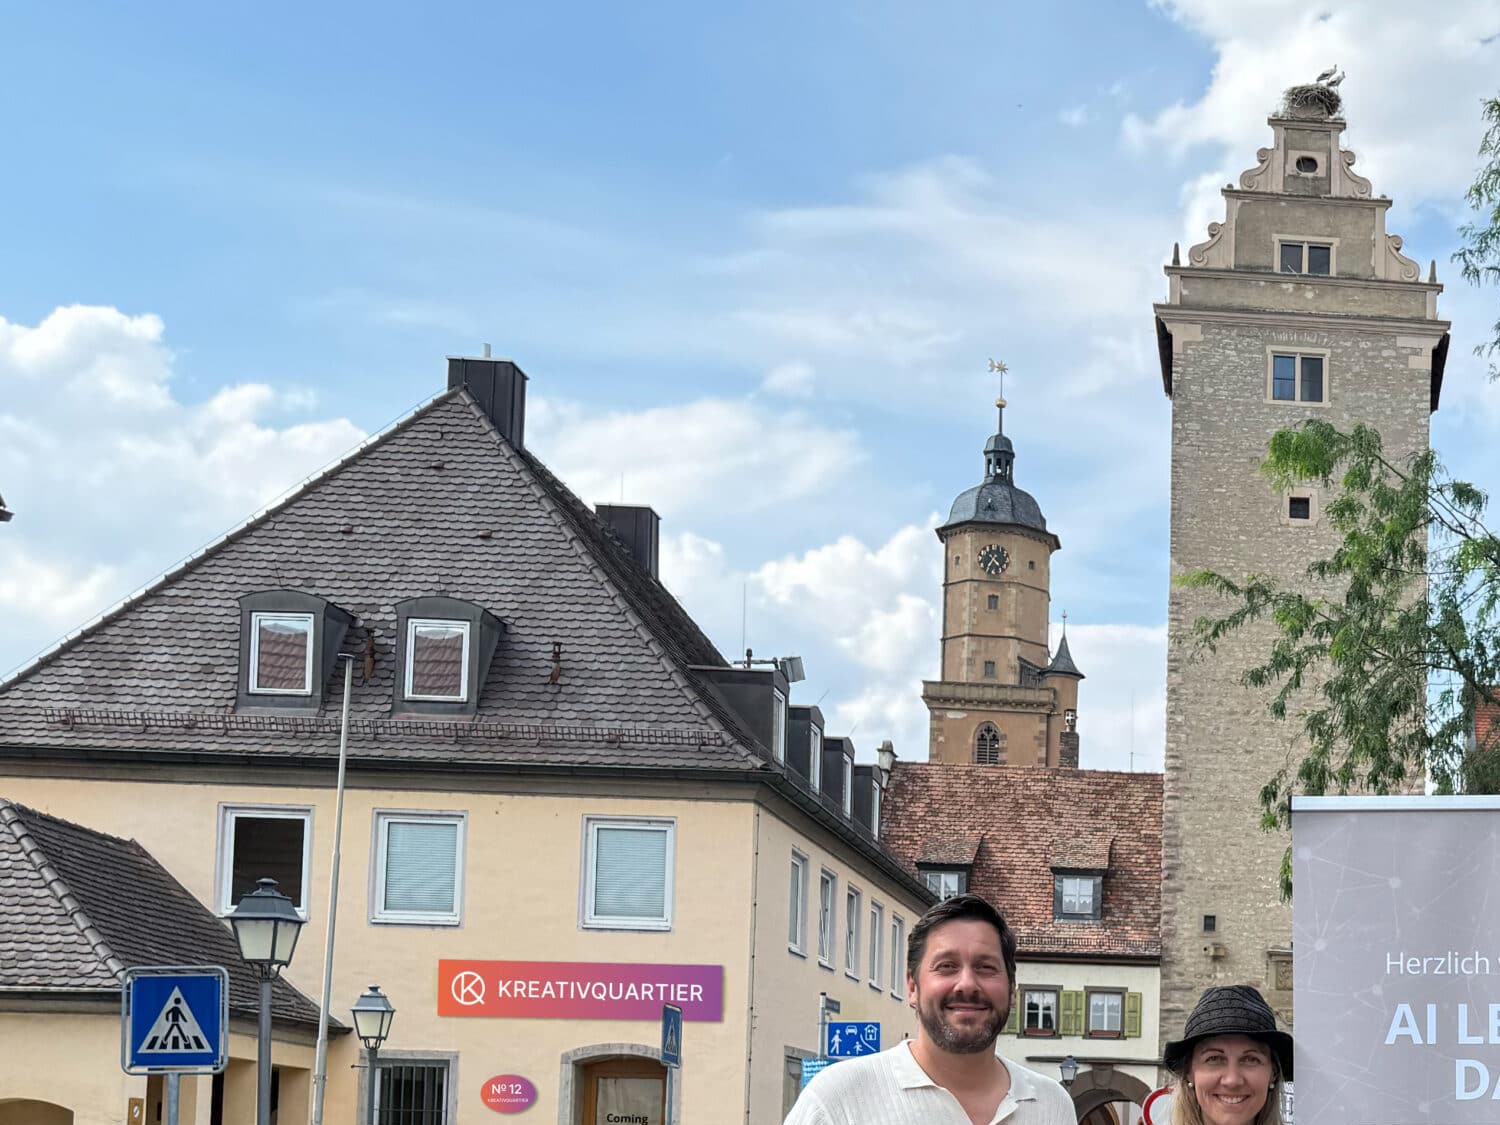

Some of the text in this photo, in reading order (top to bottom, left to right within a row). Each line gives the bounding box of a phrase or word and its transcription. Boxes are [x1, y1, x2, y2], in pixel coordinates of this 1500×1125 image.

[1386, 950, 1490, 975] Herzlich
[498, 980, 703, 1002] KREATIVQUARTIER
[1384, 1003, 1437, 1045] AI
[509, 1083, 522, 1095] 12
